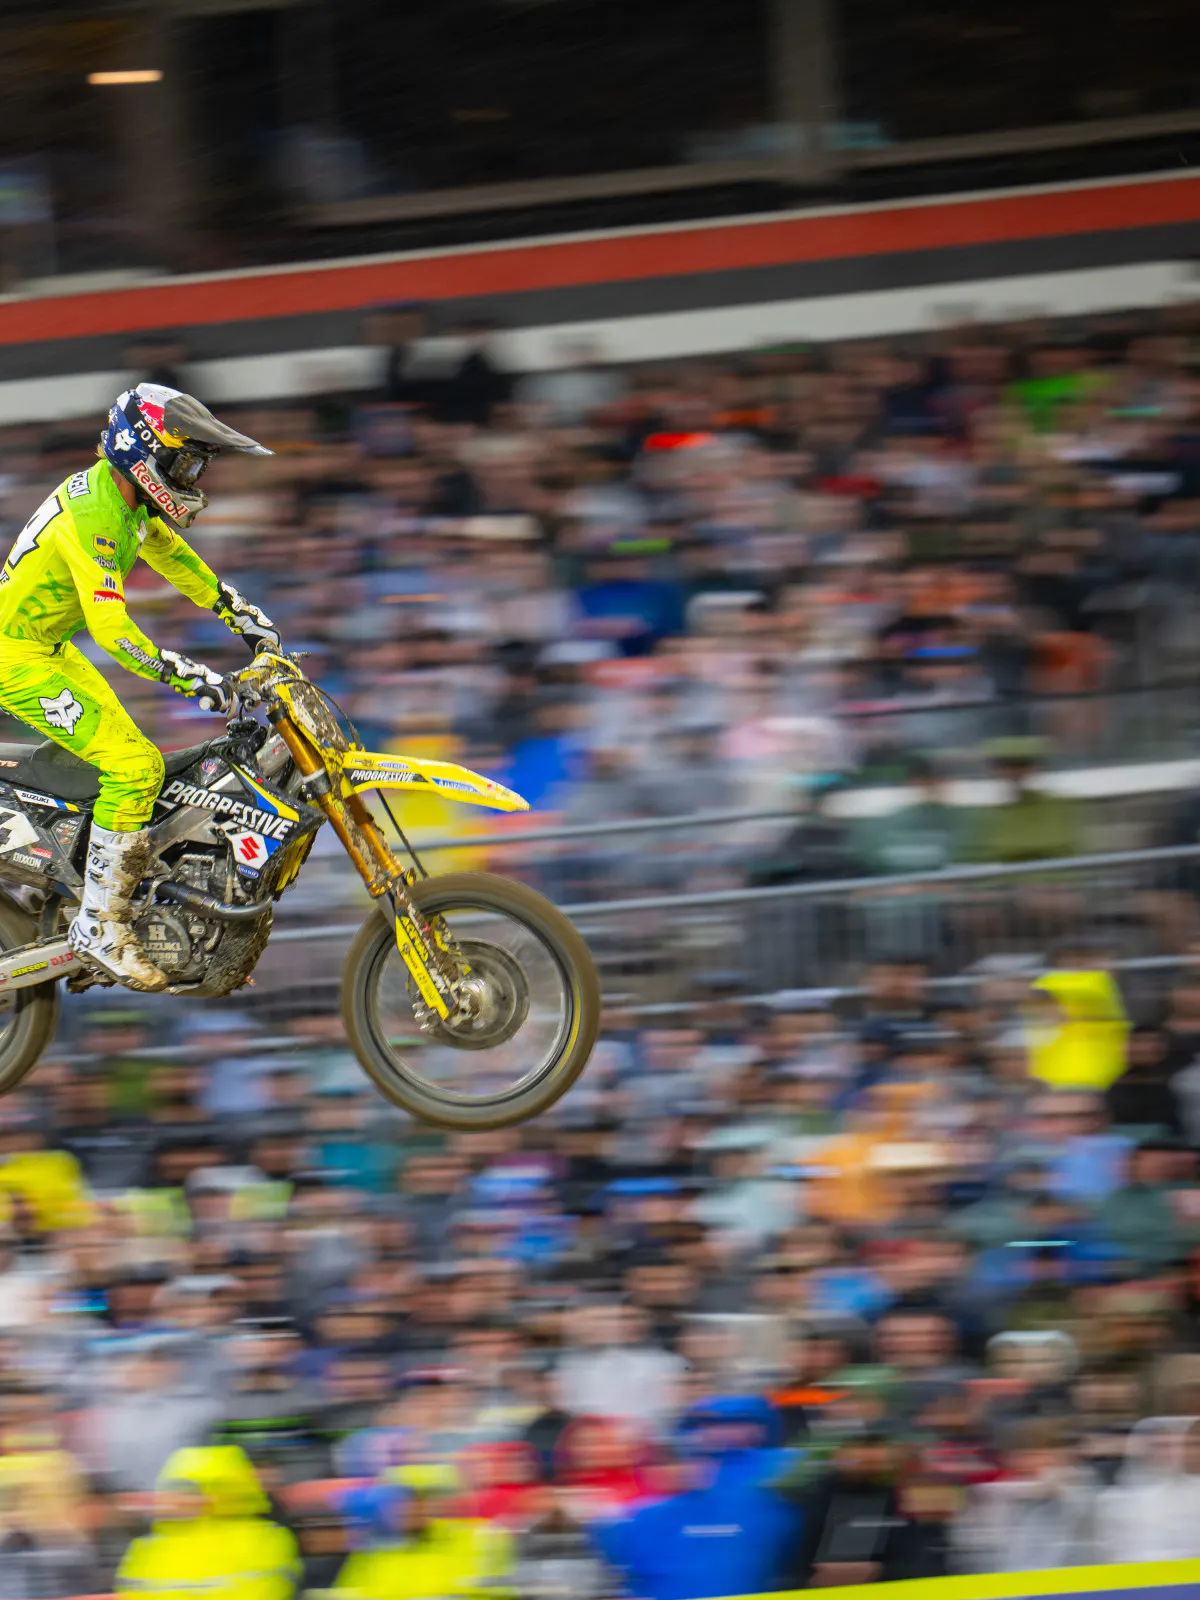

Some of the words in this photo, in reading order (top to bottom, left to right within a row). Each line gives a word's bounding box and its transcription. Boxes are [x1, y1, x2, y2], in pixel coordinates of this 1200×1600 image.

[133, 420, 162, 453] FOX
[131, 461, 163, 494] Red
[156, 491, 189, 520] Bull
[351, 769, 416, 783] PROGRESSIVE
[21, 792, 50, 804] SUZUKI
[161, 780, 293, 840] PROGRESSIVE
[12, 852, 42, 869] DIXXON
[88, 852, 110, 871] FOX
